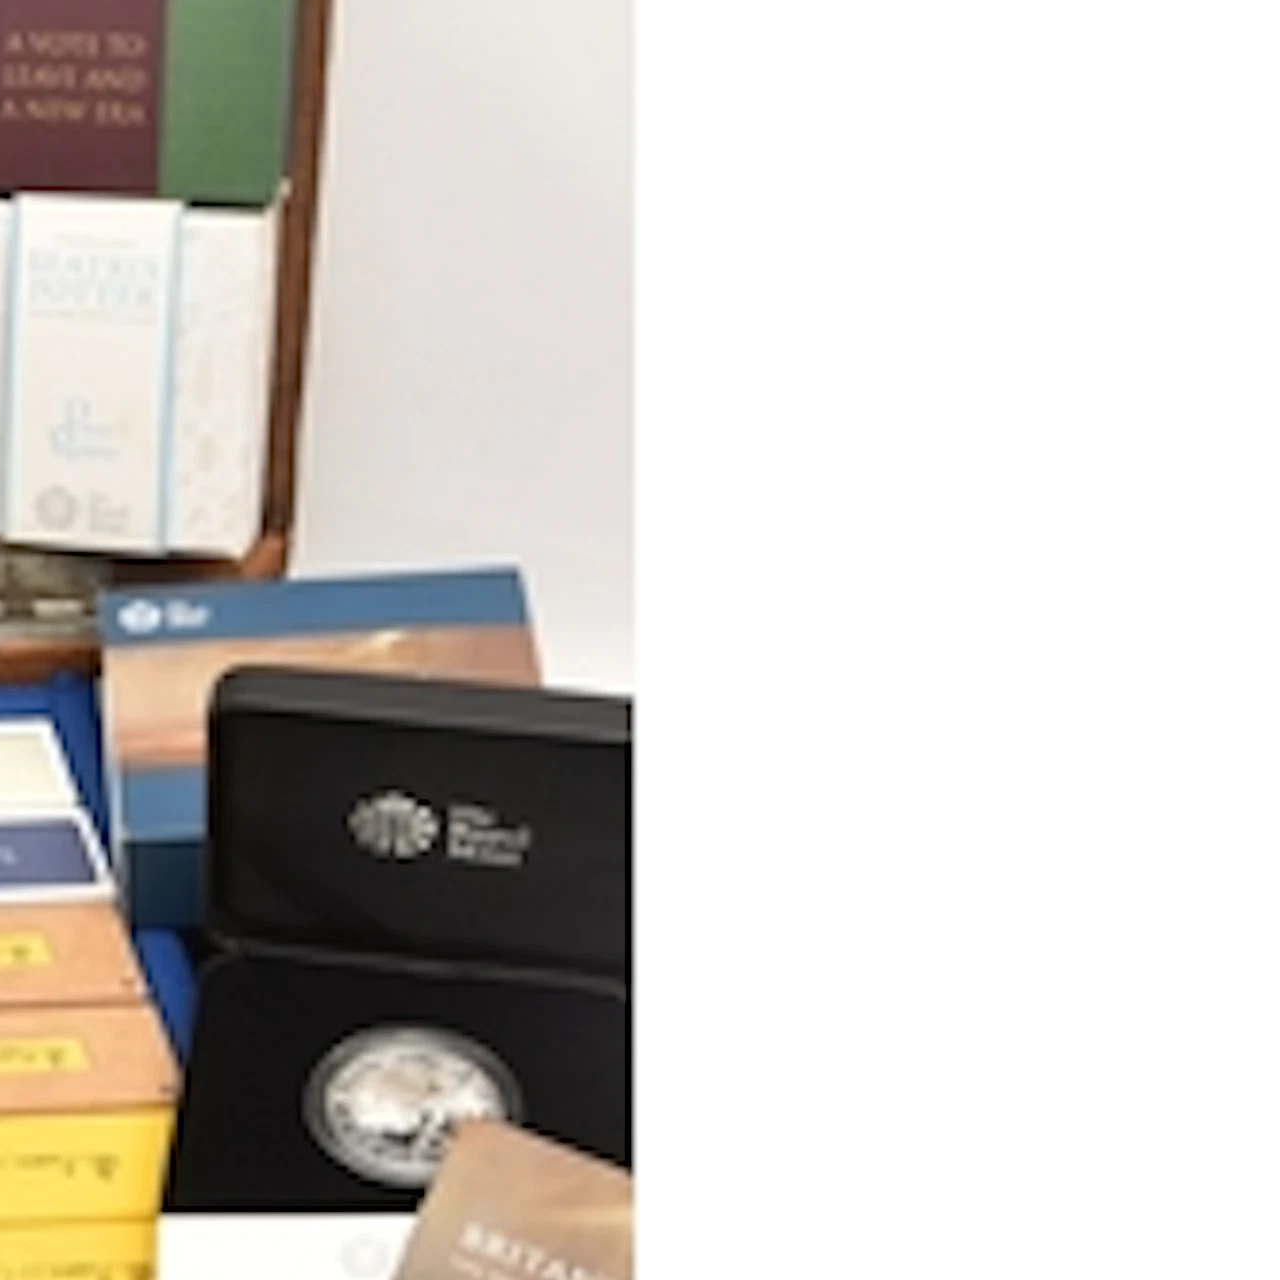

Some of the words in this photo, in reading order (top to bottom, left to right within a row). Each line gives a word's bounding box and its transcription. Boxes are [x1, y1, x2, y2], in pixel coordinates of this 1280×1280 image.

[2, 62, 77, 90] LEAVE
[83, 66, 149, 97] AND
[24, 98, 85, 123] NEW
[94, 100, 146, 128] ERA
